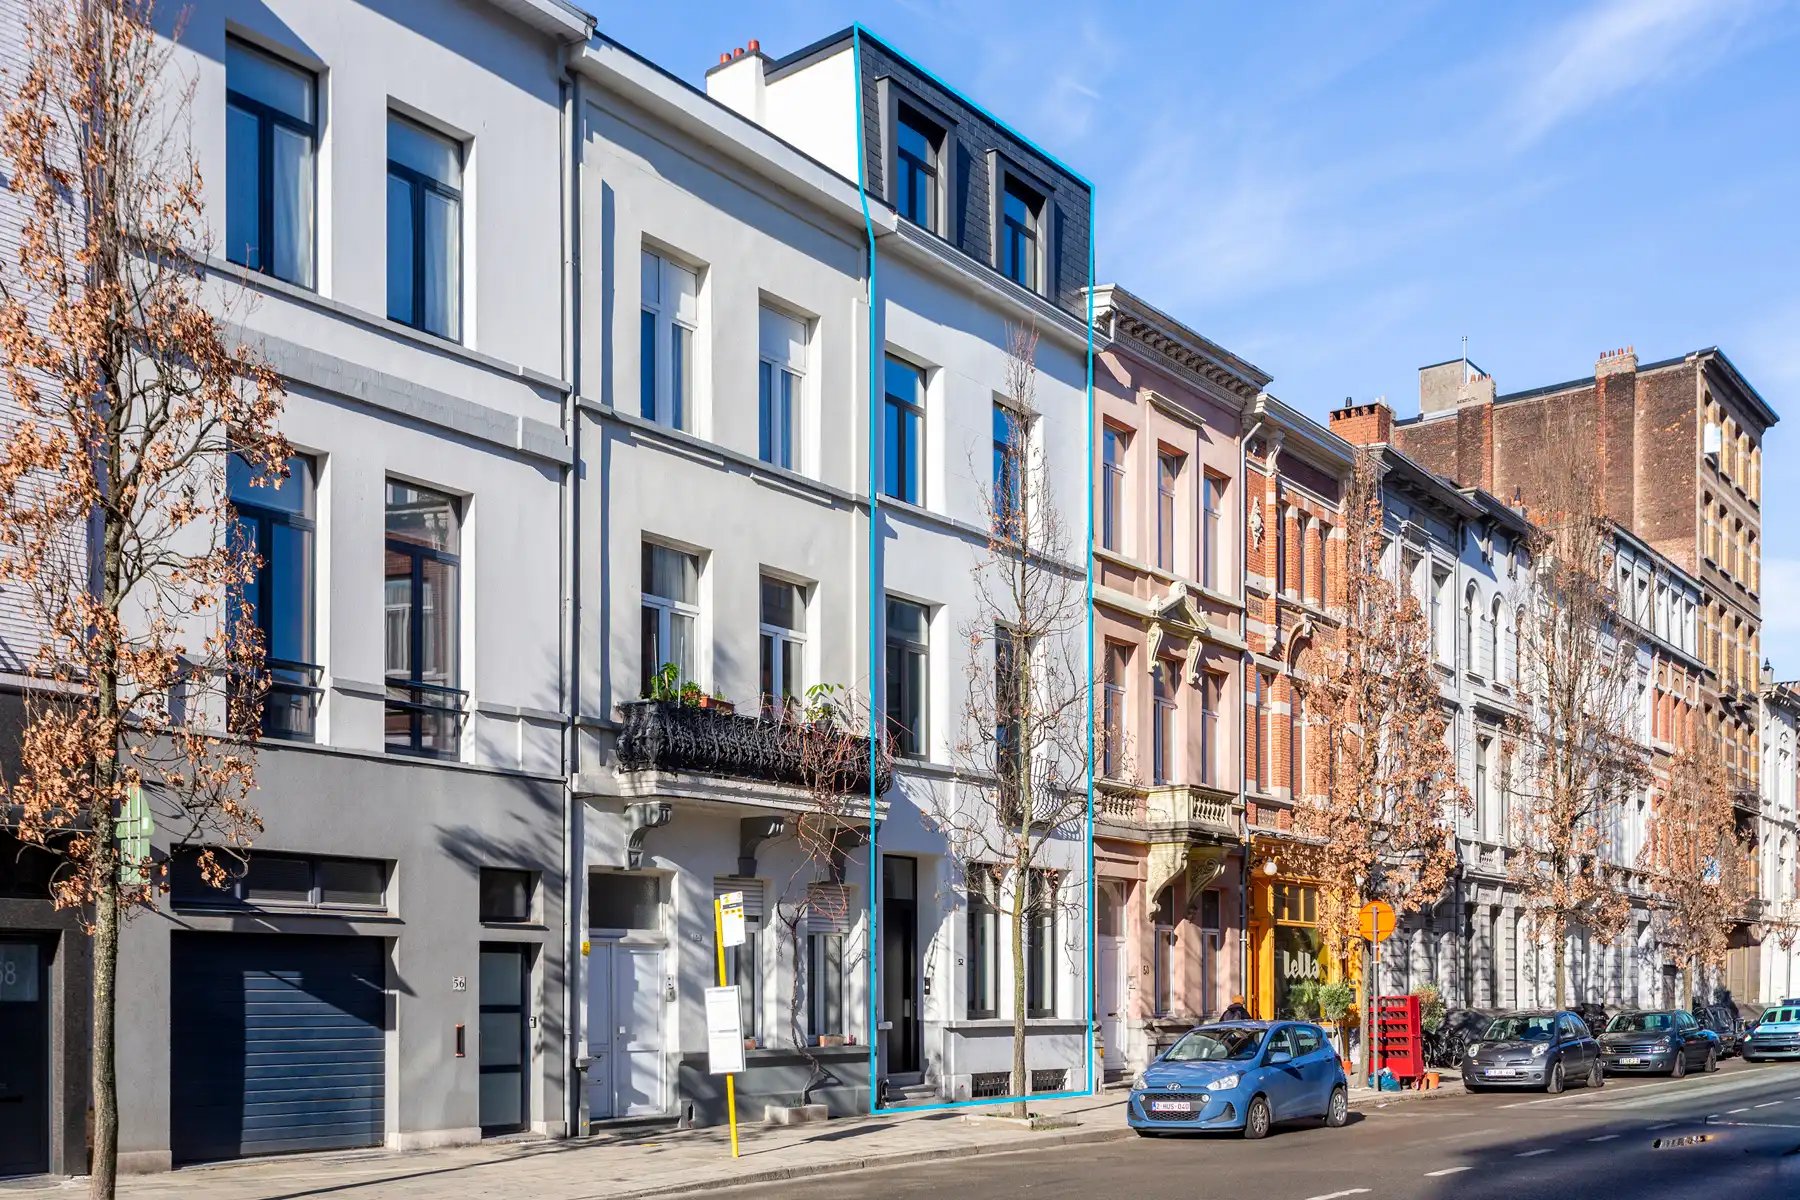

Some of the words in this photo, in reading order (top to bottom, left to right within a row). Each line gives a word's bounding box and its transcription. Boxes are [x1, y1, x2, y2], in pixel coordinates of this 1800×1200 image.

[0, 961, 16, 985] 8
[1283, 950, 1320, 979] lella
[454, 979, 465, 988] 56
